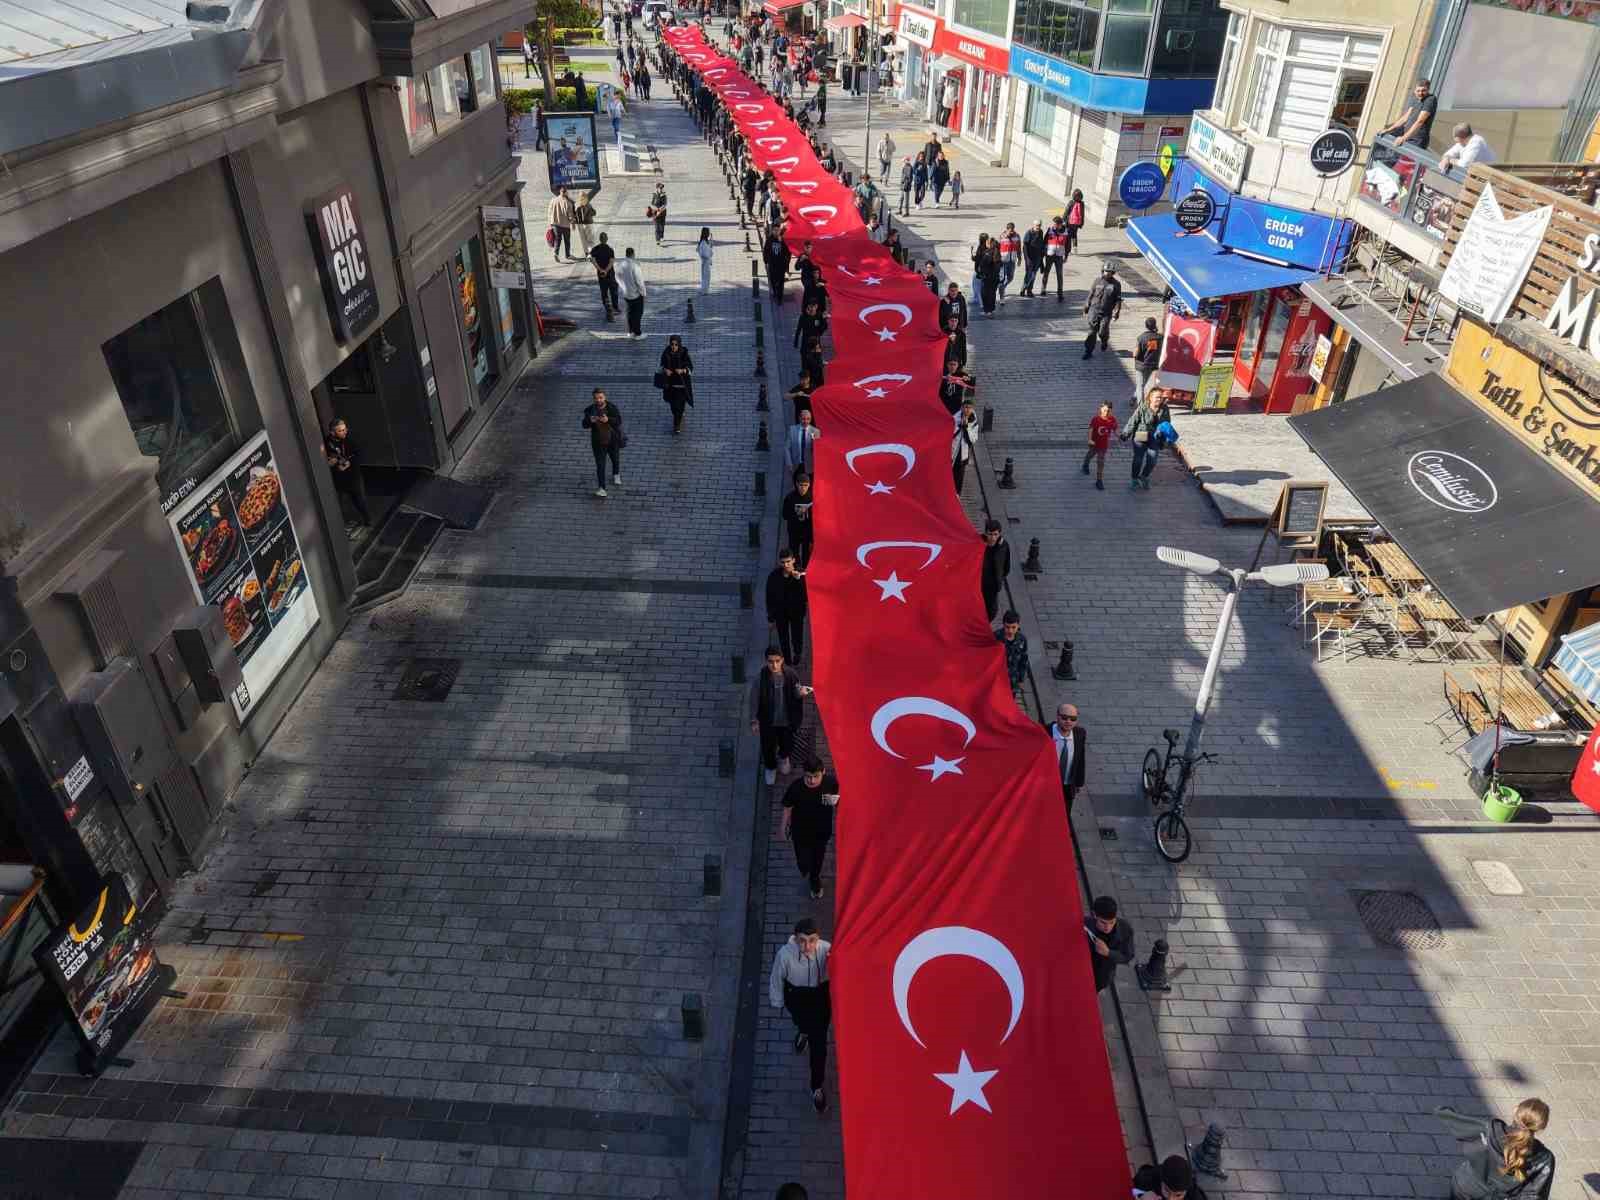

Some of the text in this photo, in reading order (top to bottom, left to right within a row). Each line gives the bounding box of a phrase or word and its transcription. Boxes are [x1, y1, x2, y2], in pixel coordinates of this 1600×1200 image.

[959, 40, 986, 61] AKBANK
[321, 194, 358, 250] MA
[1264, 218, 1304, 238] ERDEM
[1267, 234, 1295, 250] GIDA
[333, 239, 367, 296] GIC
[1543, 275, 1600, 362] M
[1523, 405, 1547, 434] &
